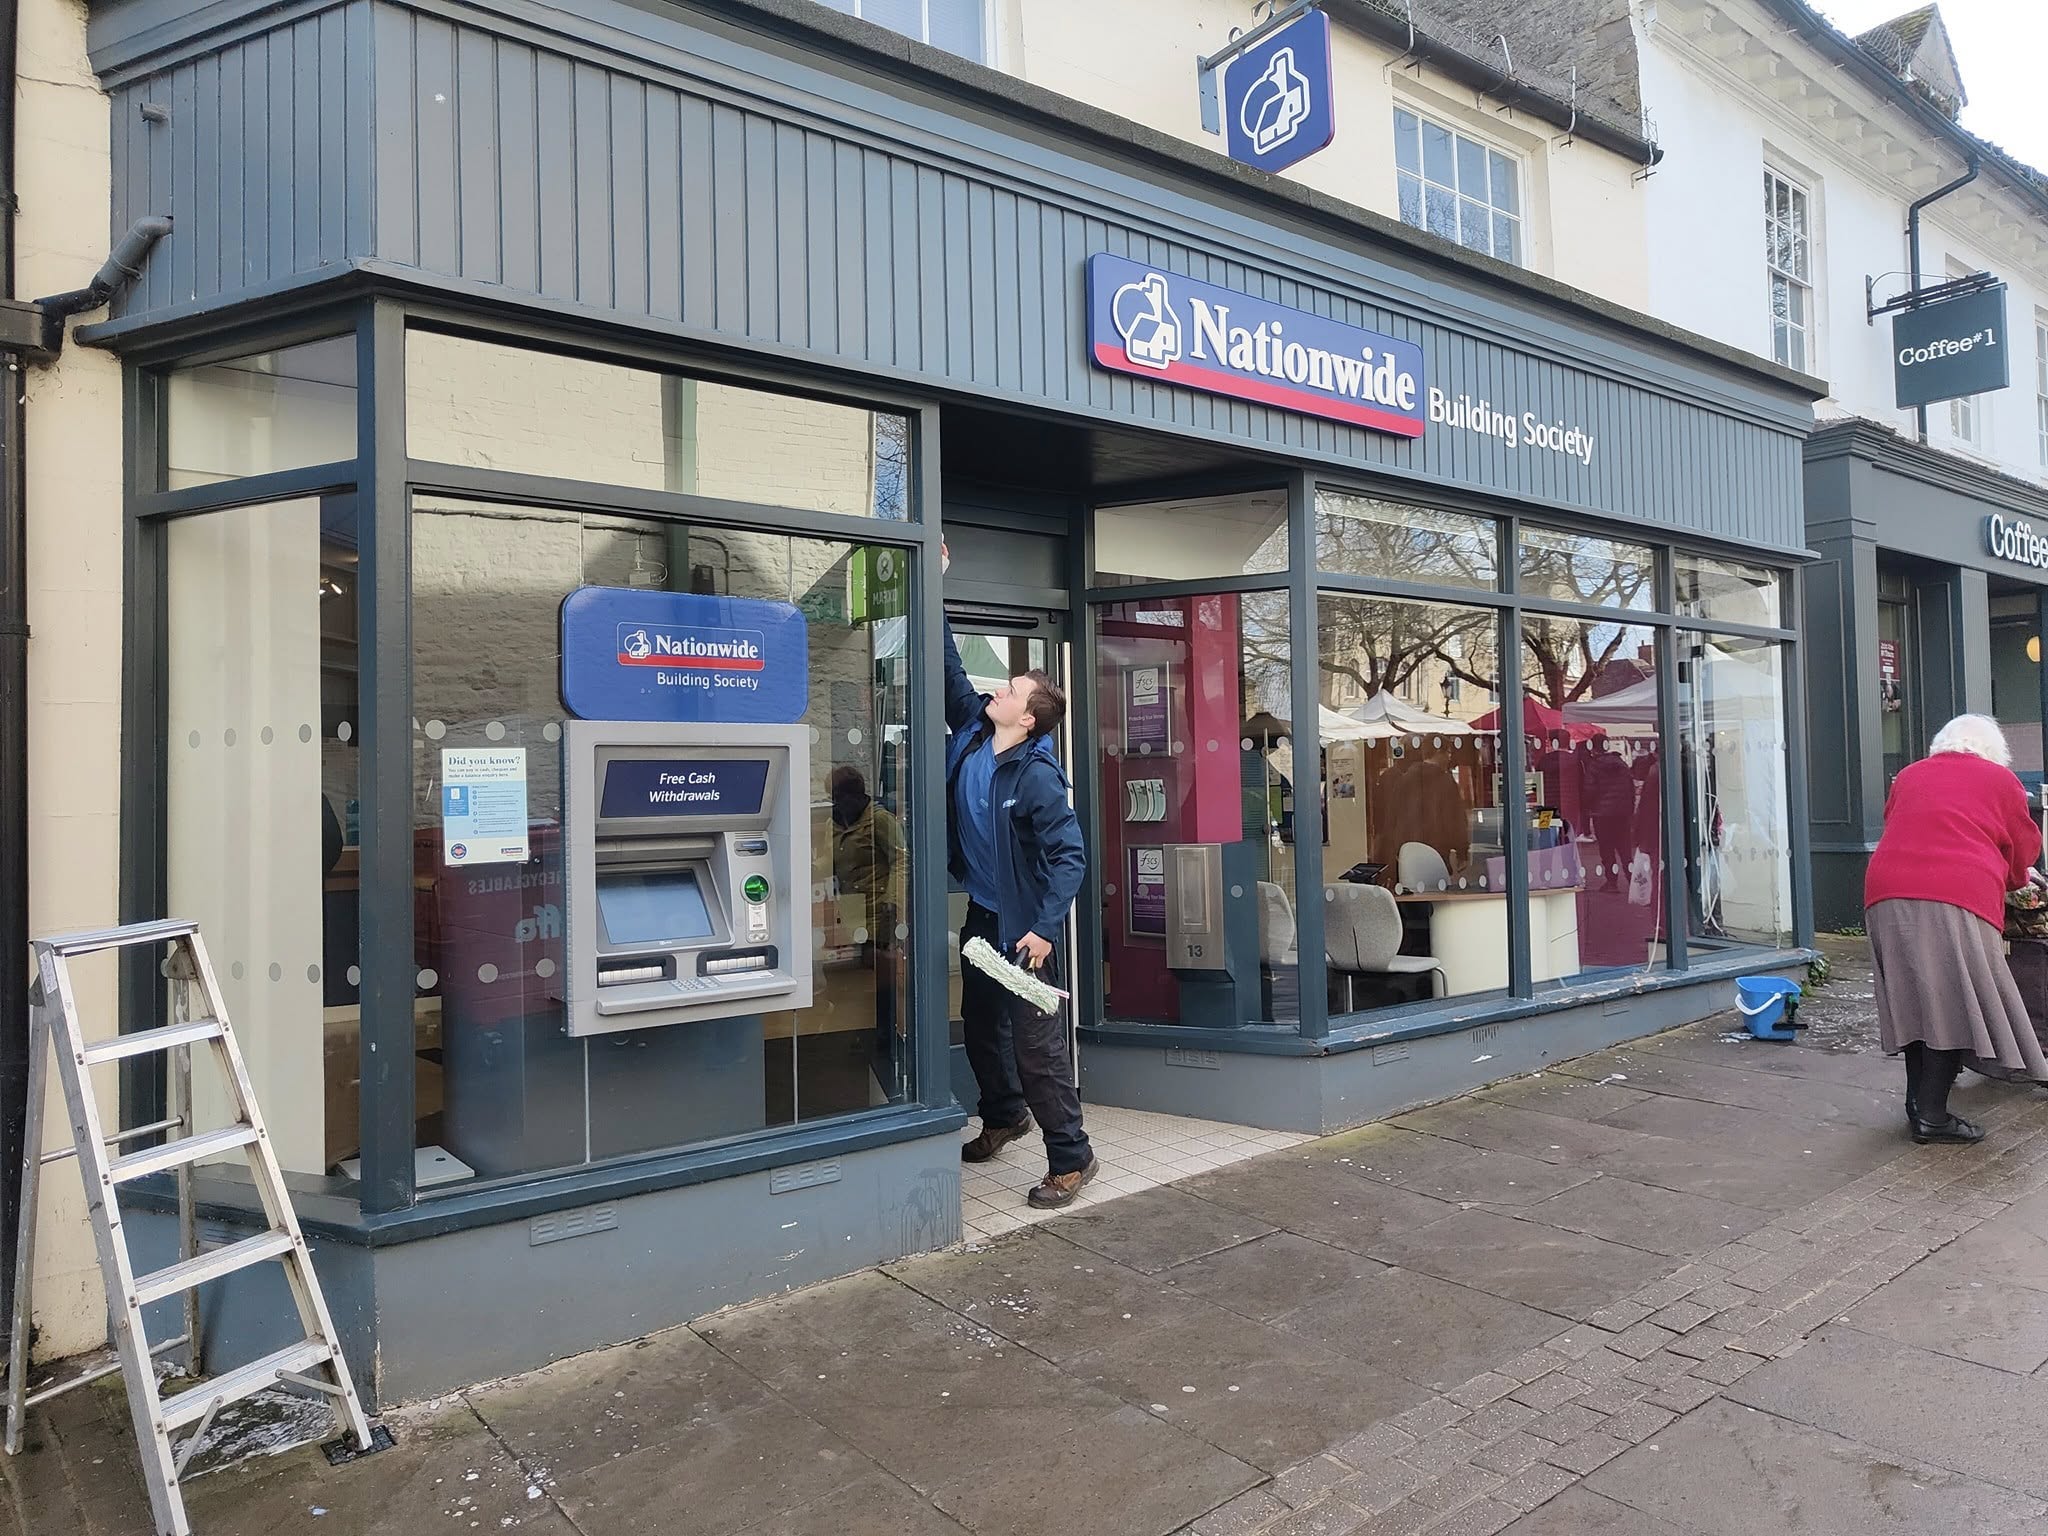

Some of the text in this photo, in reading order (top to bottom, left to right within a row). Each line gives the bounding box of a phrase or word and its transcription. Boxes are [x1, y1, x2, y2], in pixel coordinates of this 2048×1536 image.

[1188, 296, 1417, 412] Nationwide
[1429, 386, 1595, 466] Building Society
[1990, 513, 2048, 569] Coffee
[655, 634, 759, 659] Nationwide
[656, 672, 759, 691] Building Society
[448, 756, 521, 767] Did you know?
[659, 772, 716, 785] Free Cash
[649, 789, 720, 803] Withdrawals
[1187, 945, 1203, 957] 13
